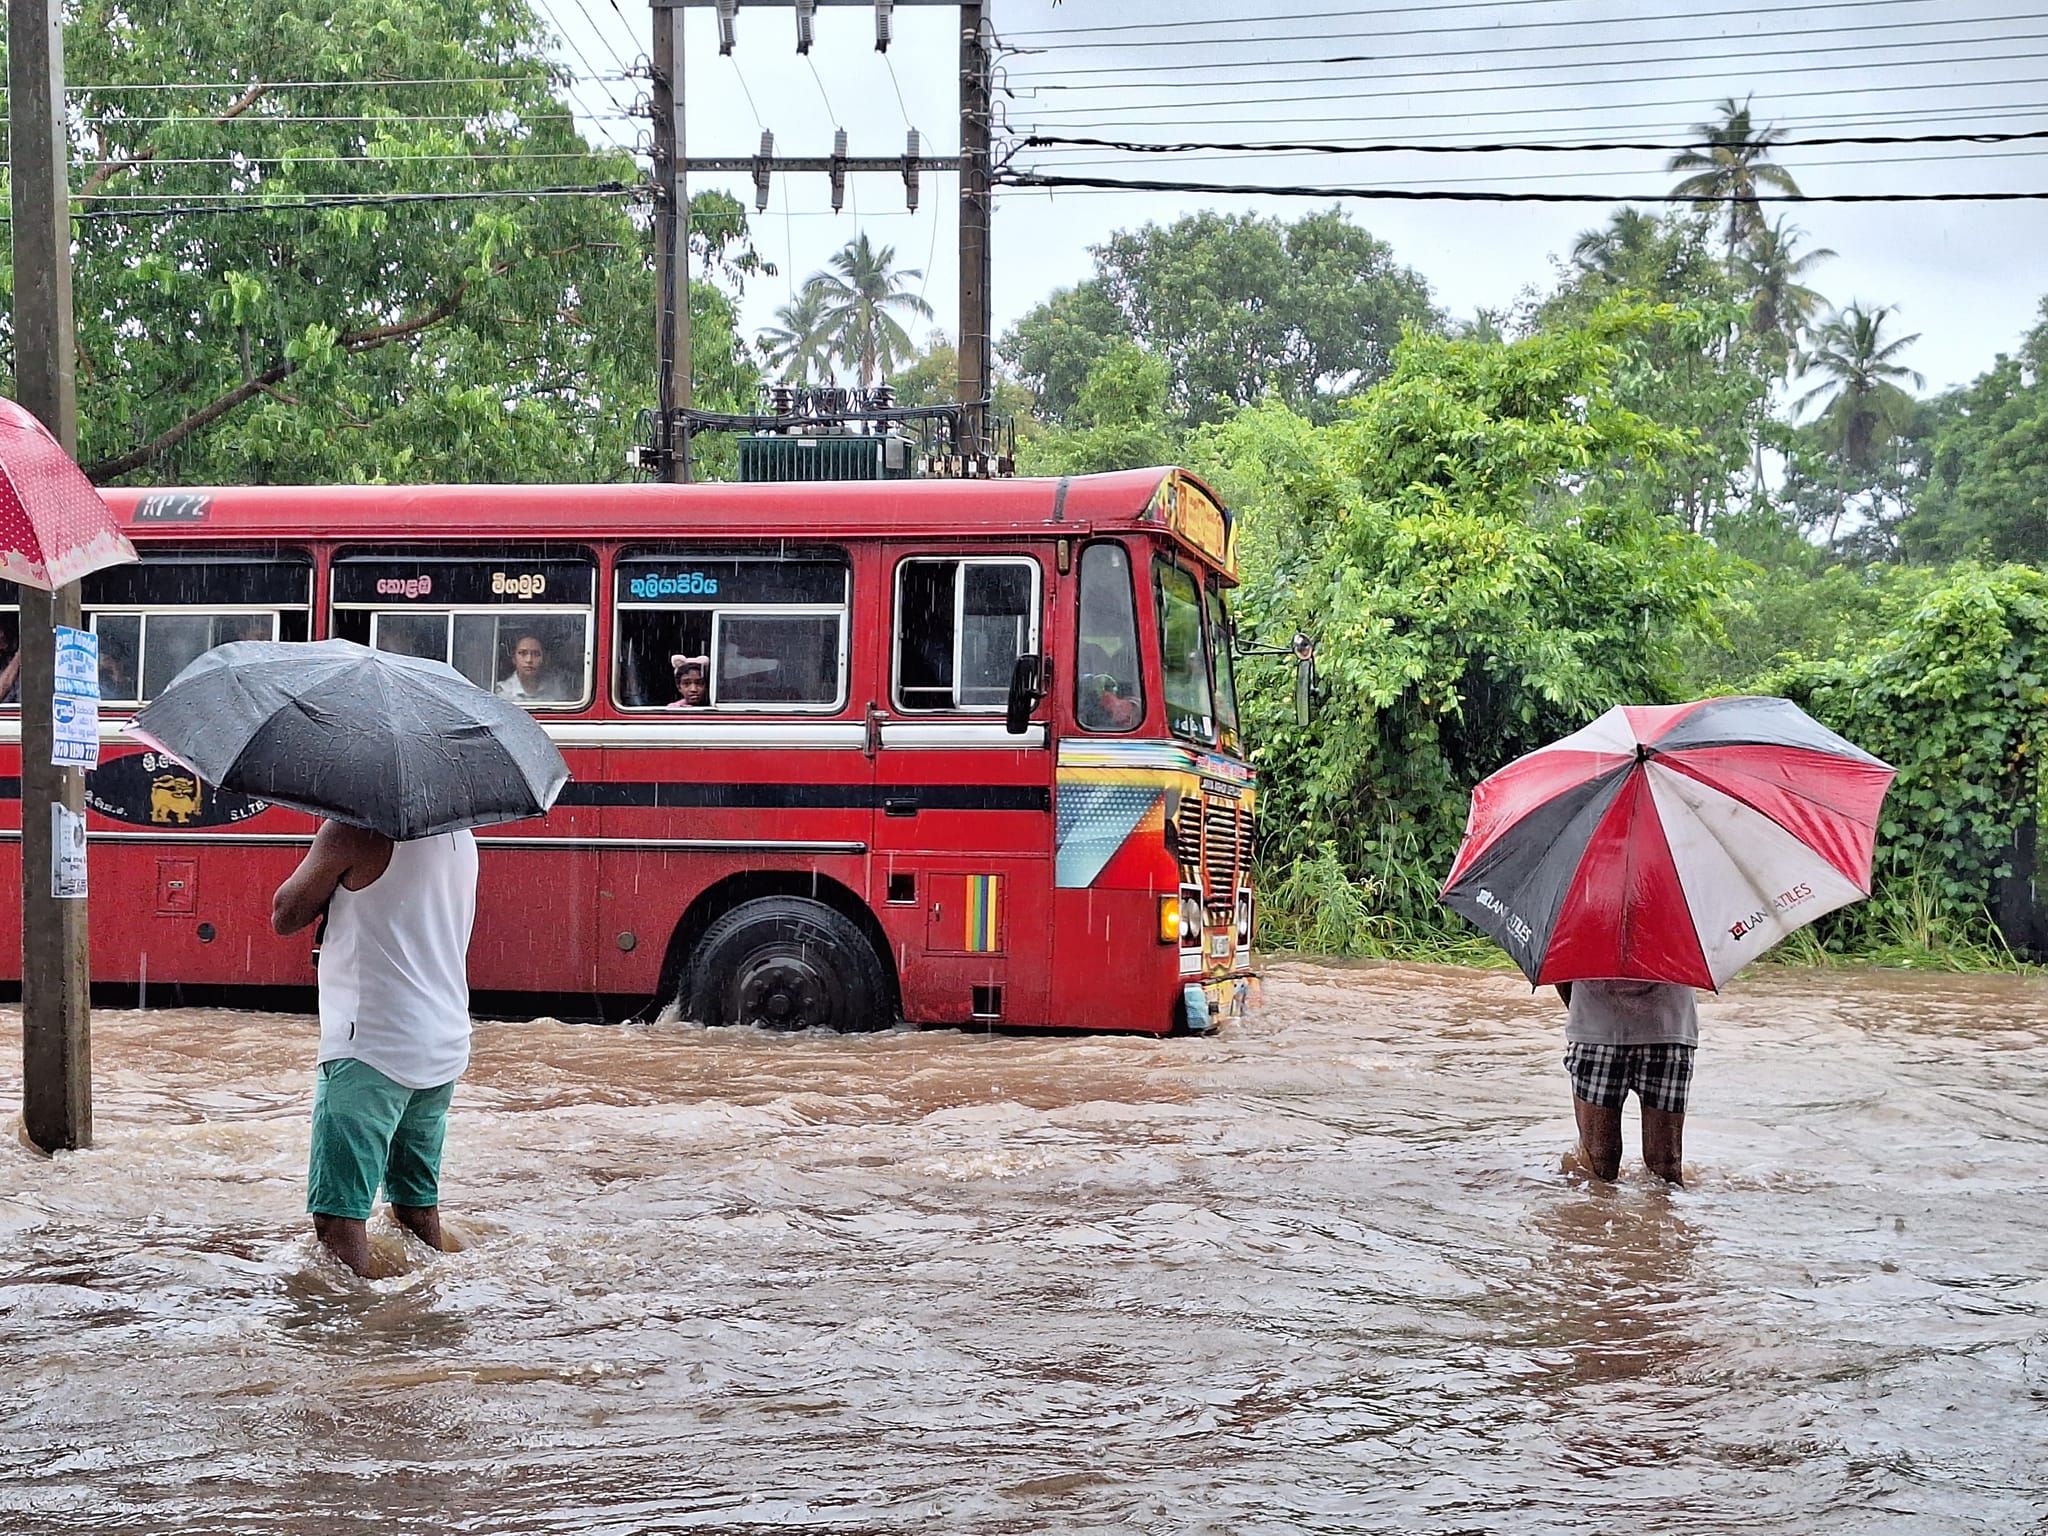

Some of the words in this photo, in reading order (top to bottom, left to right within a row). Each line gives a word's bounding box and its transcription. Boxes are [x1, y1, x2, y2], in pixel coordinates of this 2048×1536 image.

[143, 495, 175, 516] KP
[177, 495, 210, 516] 72
[376, 575, 432, 599] කොළඹ
